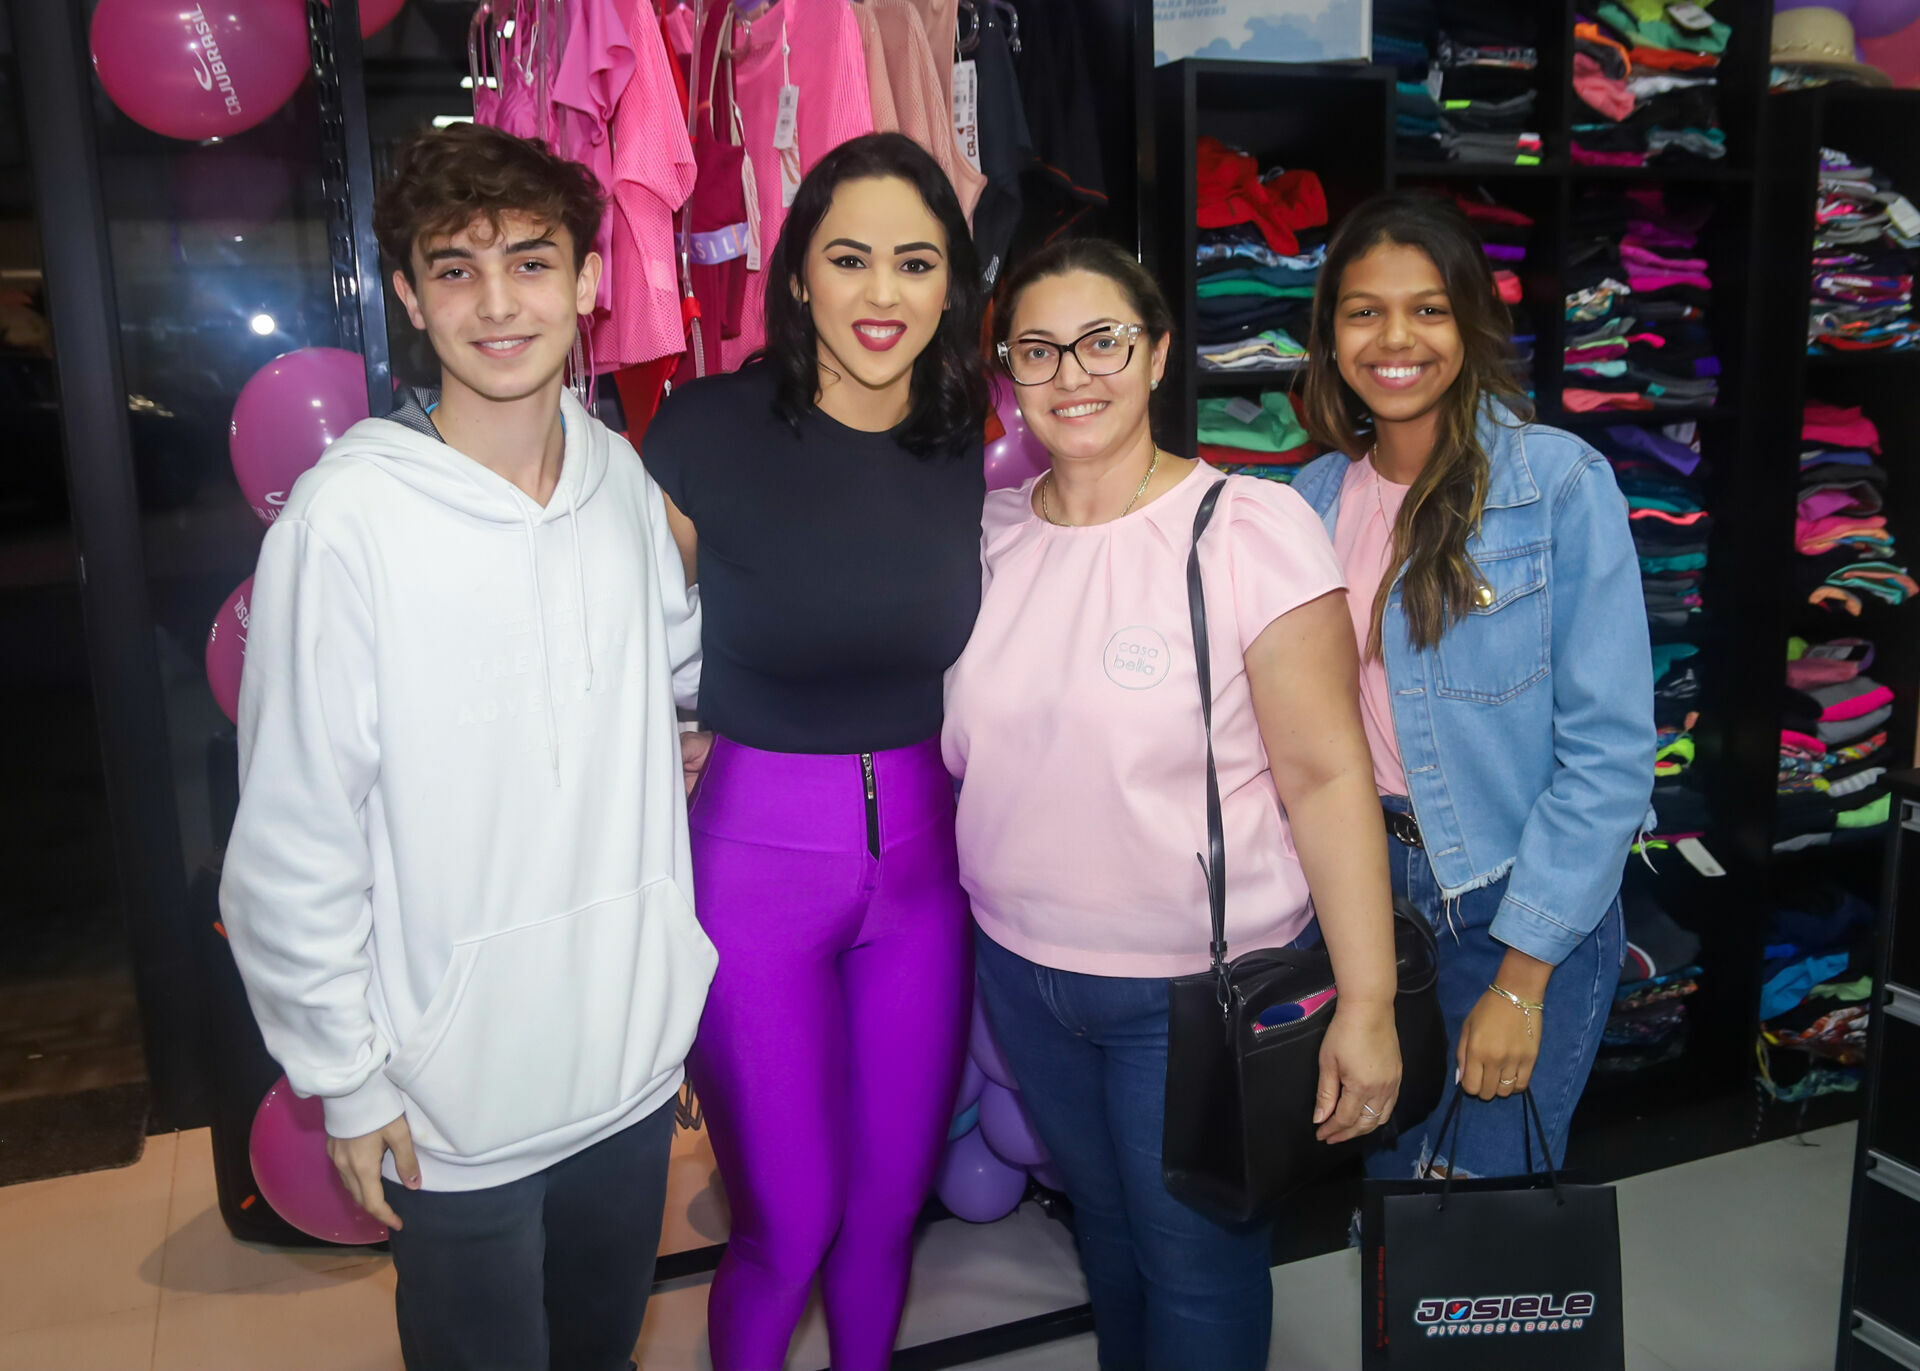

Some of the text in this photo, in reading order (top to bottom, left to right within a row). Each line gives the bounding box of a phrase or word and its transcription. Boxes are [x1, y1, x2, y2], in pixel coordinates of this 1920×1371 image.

[189, 3, 242, 116] CAJUBRASIL
[1113, 654, 1156, 675] bella
[1426, 1318, 1584, 1337] FITNESS & BEACH
